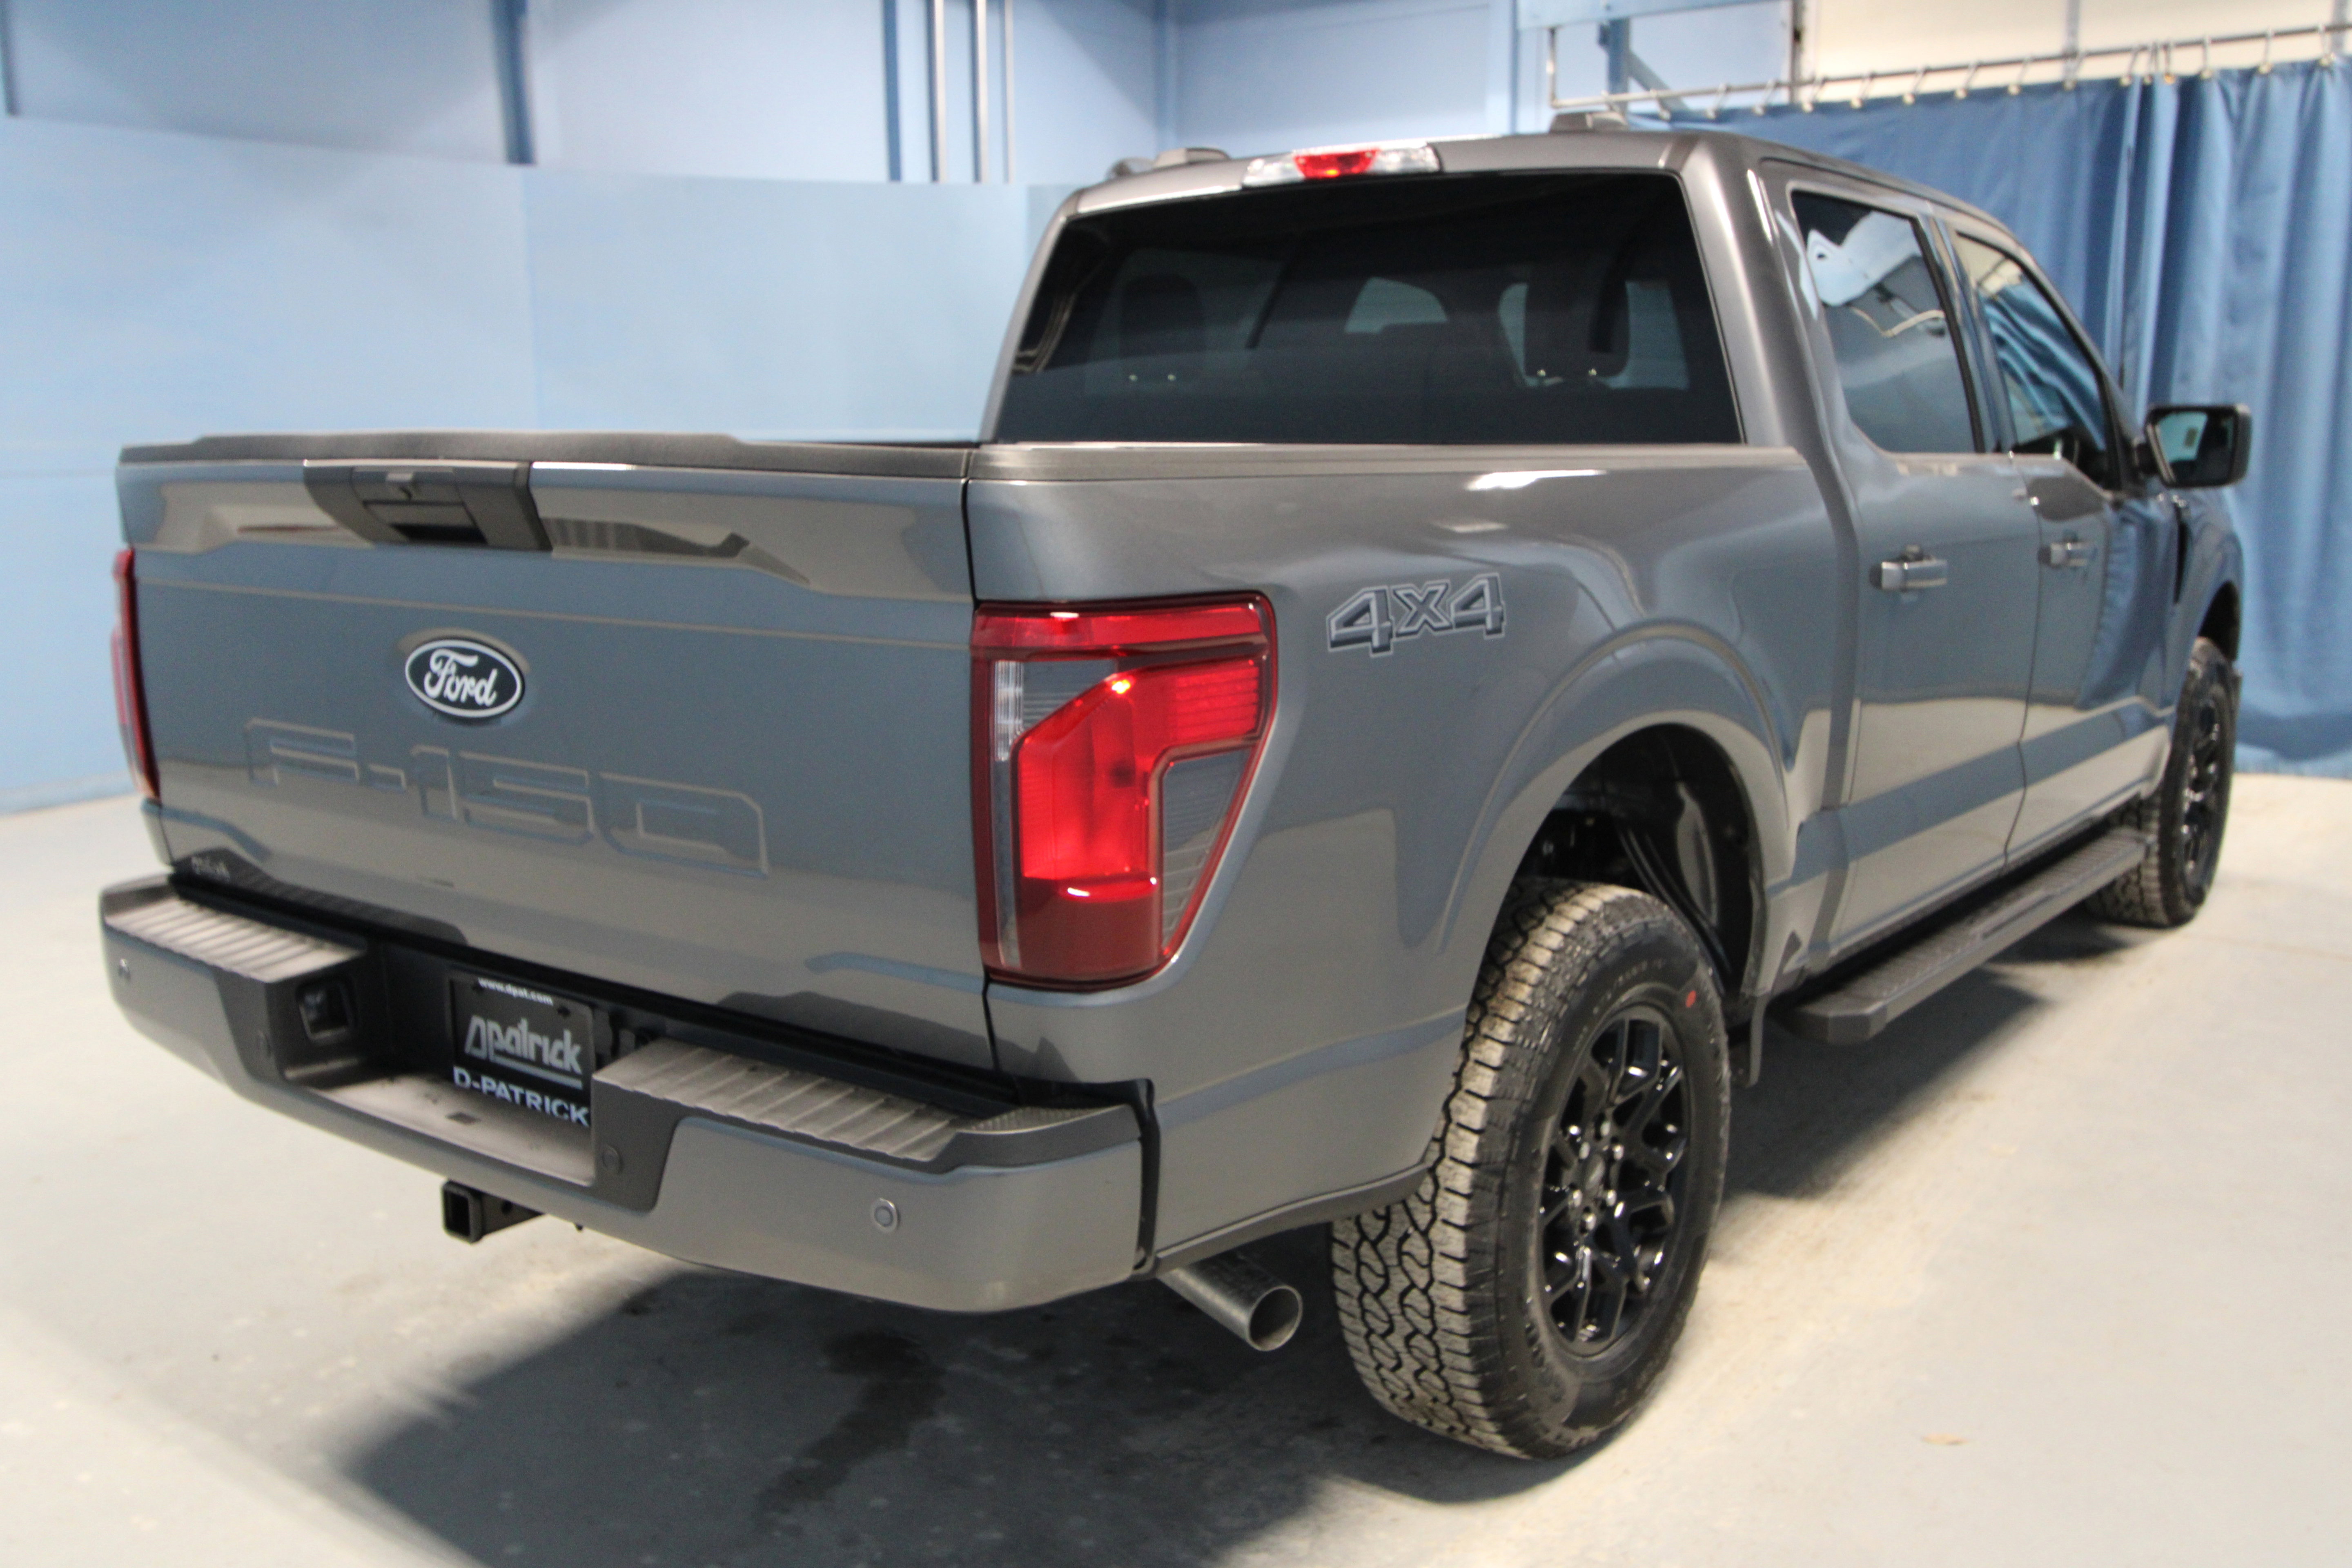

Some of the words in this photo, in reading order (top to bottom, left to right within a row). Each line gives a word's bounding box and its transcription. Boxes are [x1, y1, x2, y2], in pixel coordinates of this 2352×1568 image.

[423, 648, 498, 706] Ford
[245, 717, 770, 879] F-150
[477, 977, 553, 1006] www.dpat.com
[453, 1065, 589, 1127] D-PATRICK
